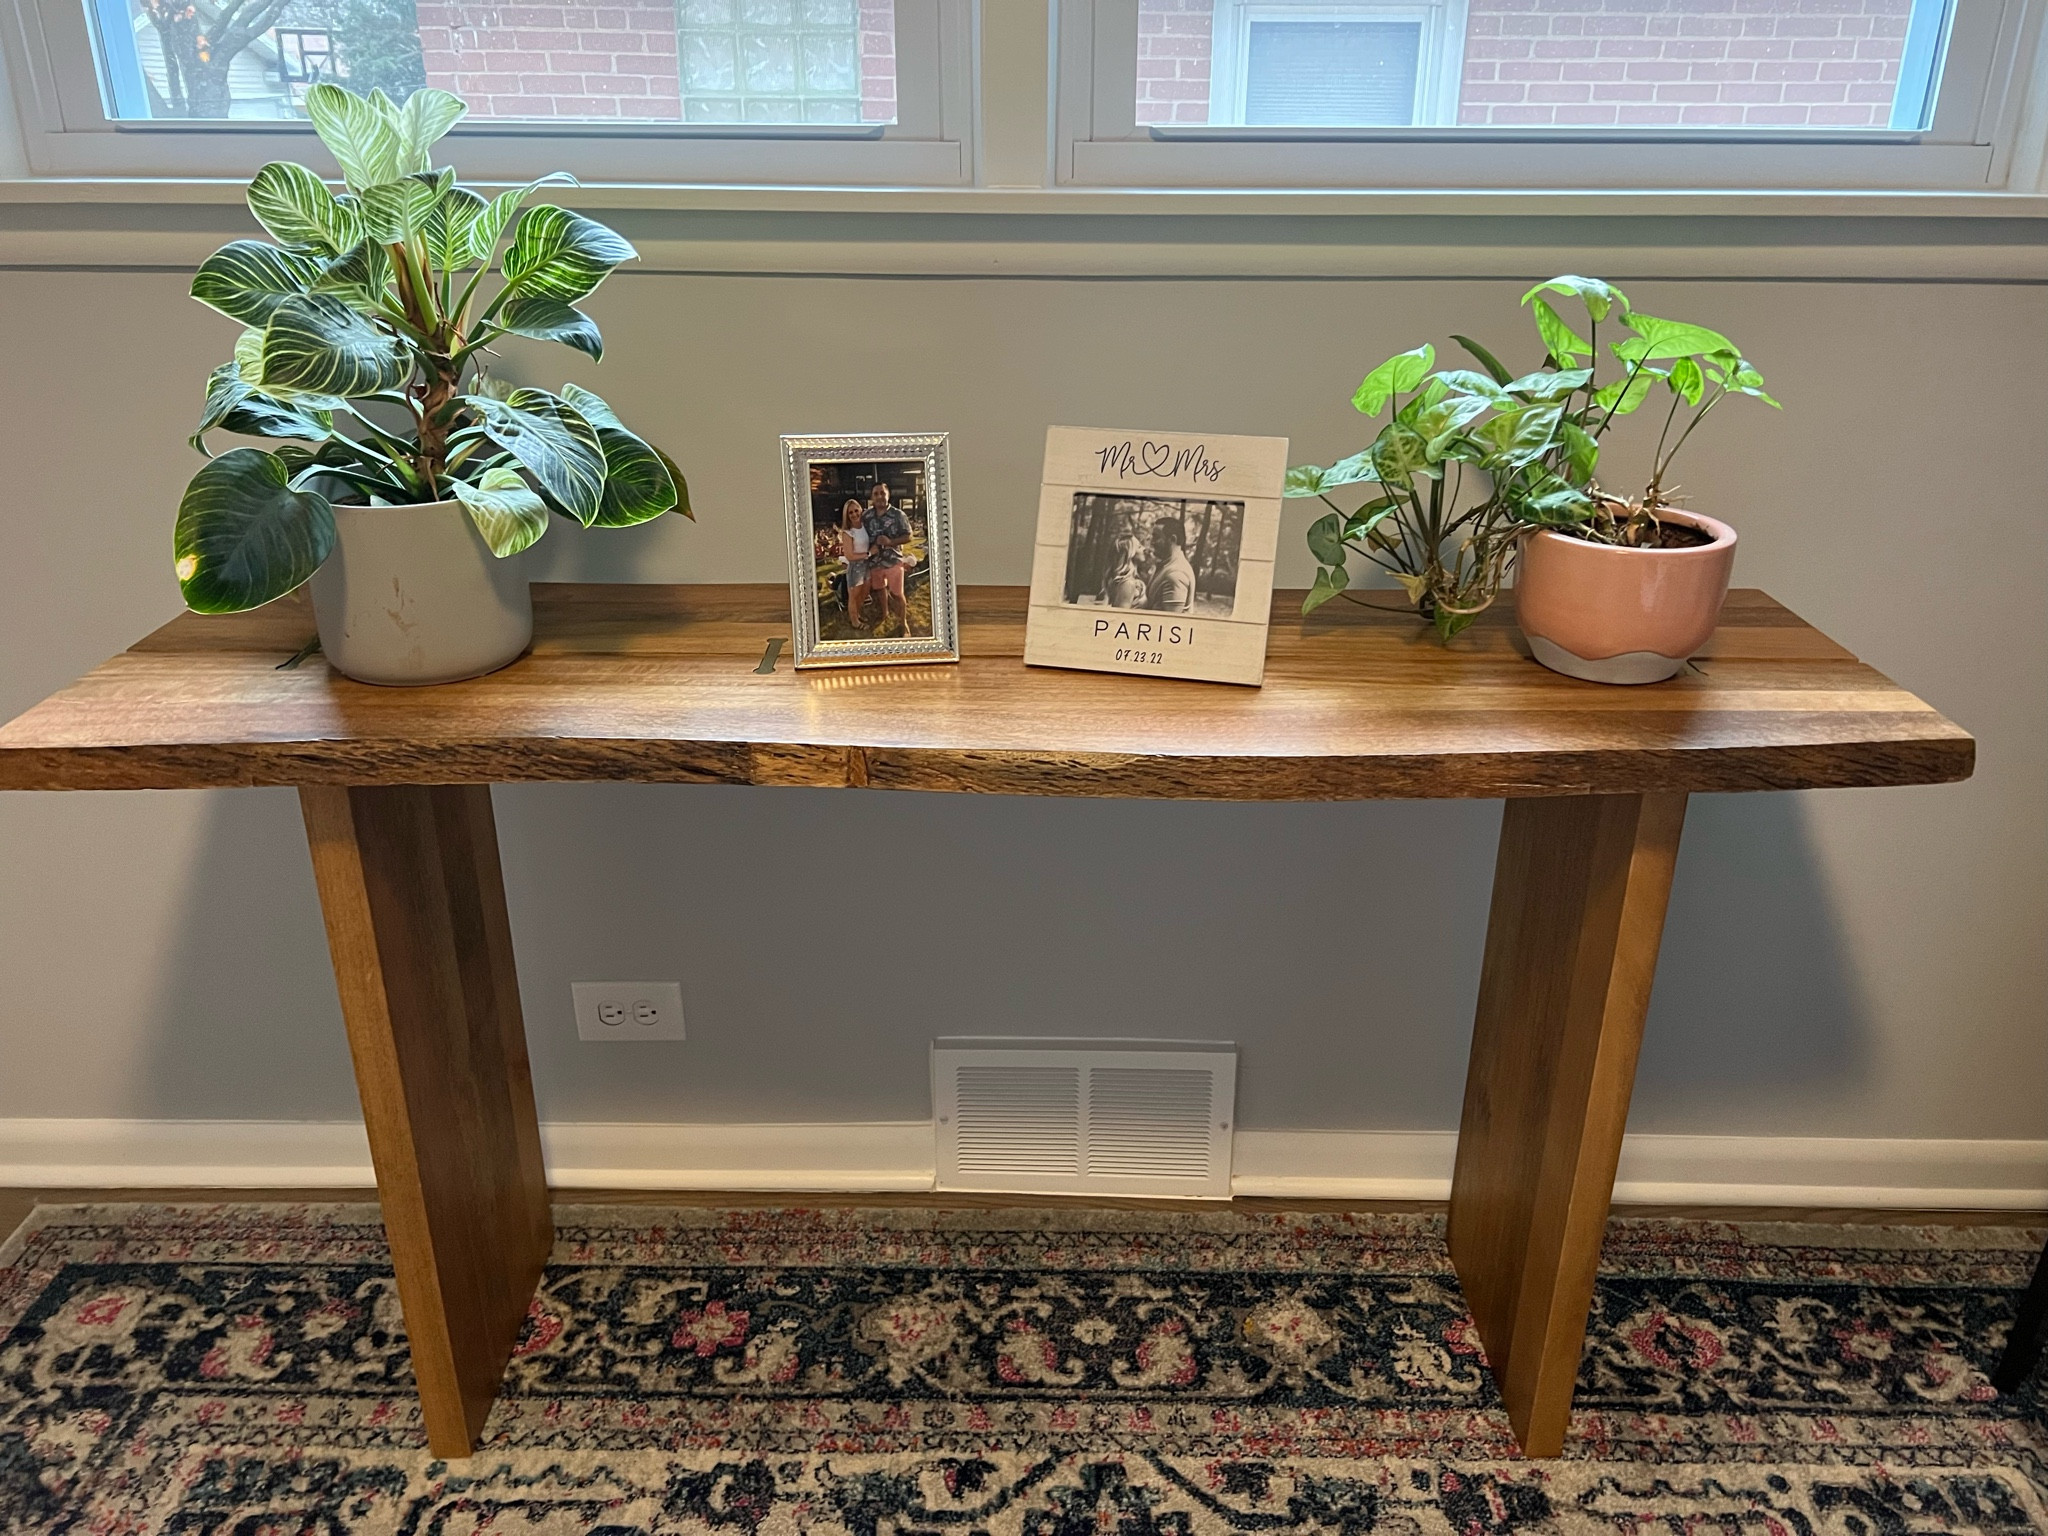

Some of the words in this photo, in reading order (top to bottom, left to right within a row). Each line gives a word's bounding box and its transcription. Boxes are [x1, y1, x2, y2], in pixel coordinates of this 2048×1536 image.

[1095, 441, 1136, 479] Mr
[1173, 445, 1226, 482] Mrs
[1094, 619, 1194, 645] PARISI
[1115, 648, 1163, 665] 07.23.22
